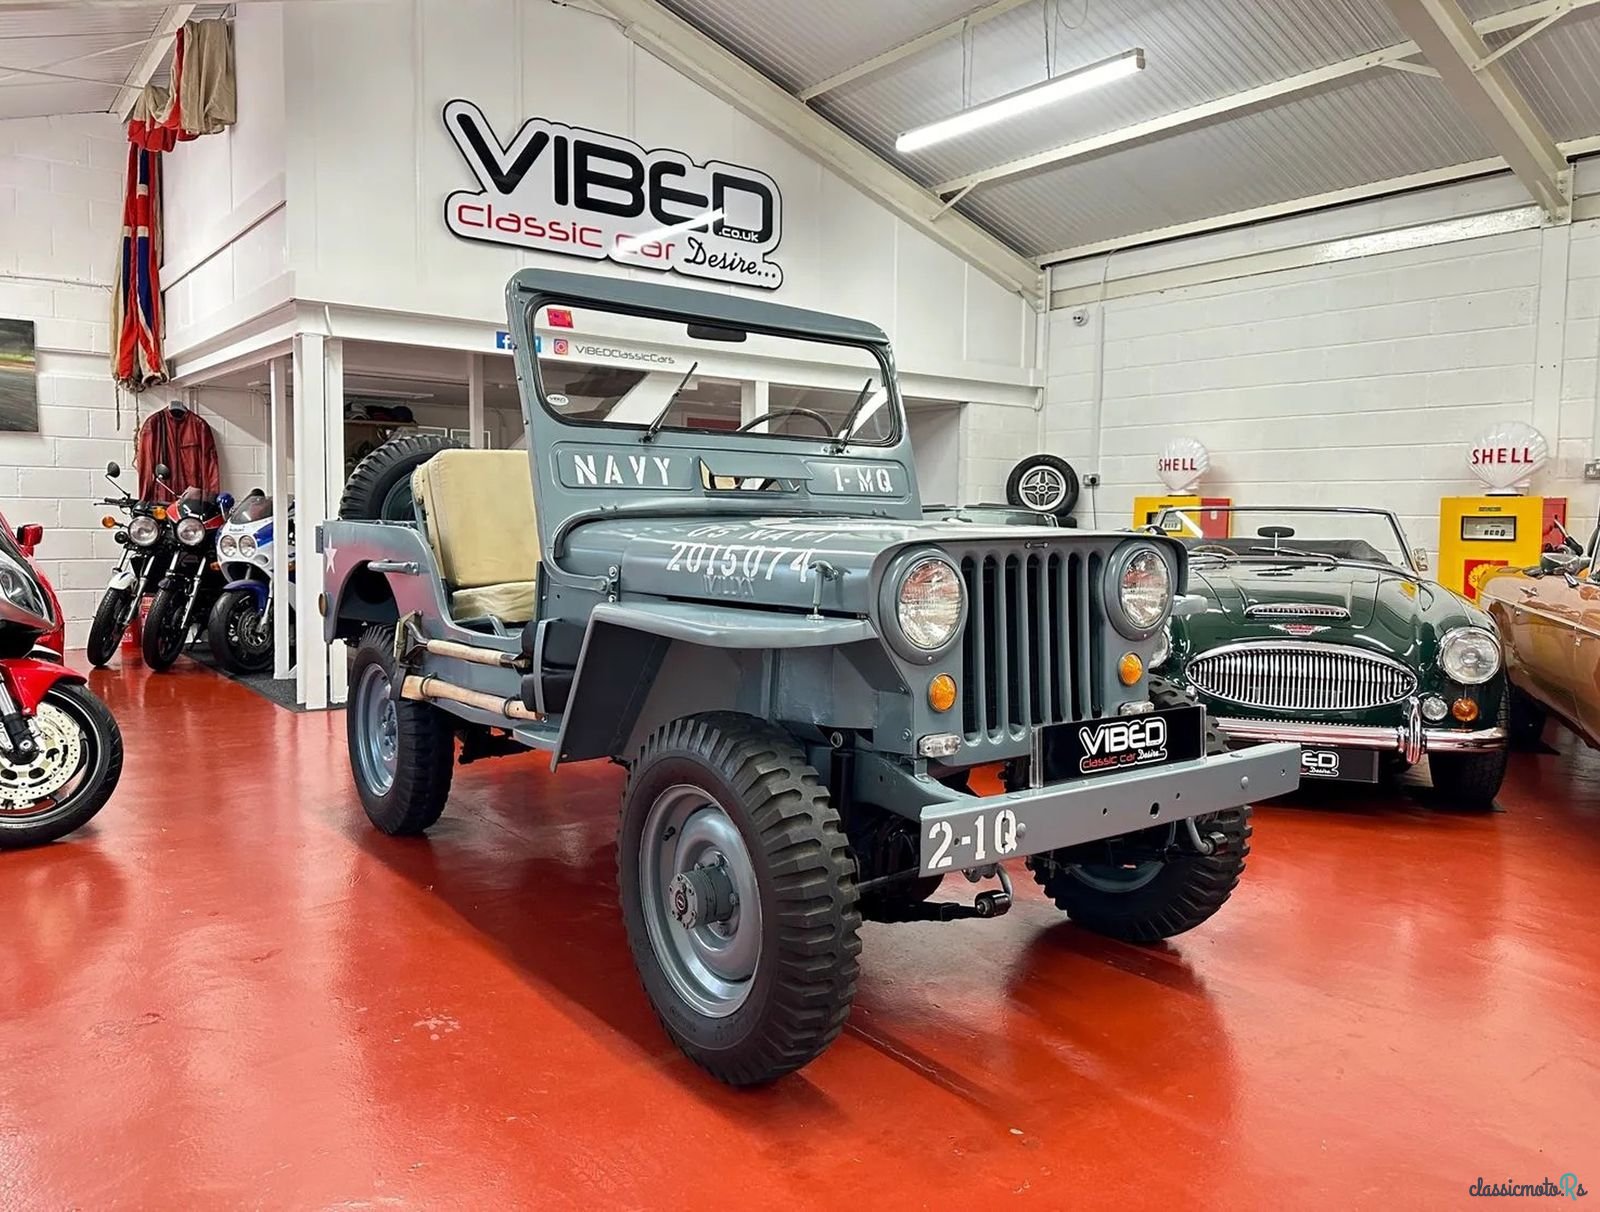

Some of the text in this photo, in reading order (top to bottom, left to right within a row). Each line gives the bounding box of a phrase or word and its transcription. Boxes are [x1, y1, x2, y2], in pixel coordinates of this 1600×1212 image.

[456, 113, 773, 243] VIBED
[457, 203, 602, 248] classic
[615, 233, 675, 260] car
[719, 227, 759, 242] .co.uk
[574, 455, 670, 486] NAVY
[1158, 458, 1198, 471] SHELL
[1471, 447, 1534, 465] SHELL
[666, 541, 816, 583] 2015074
[1082, 721, 1164, 756] VIBED
[928, 809, 1018, 869] 2-1Q
